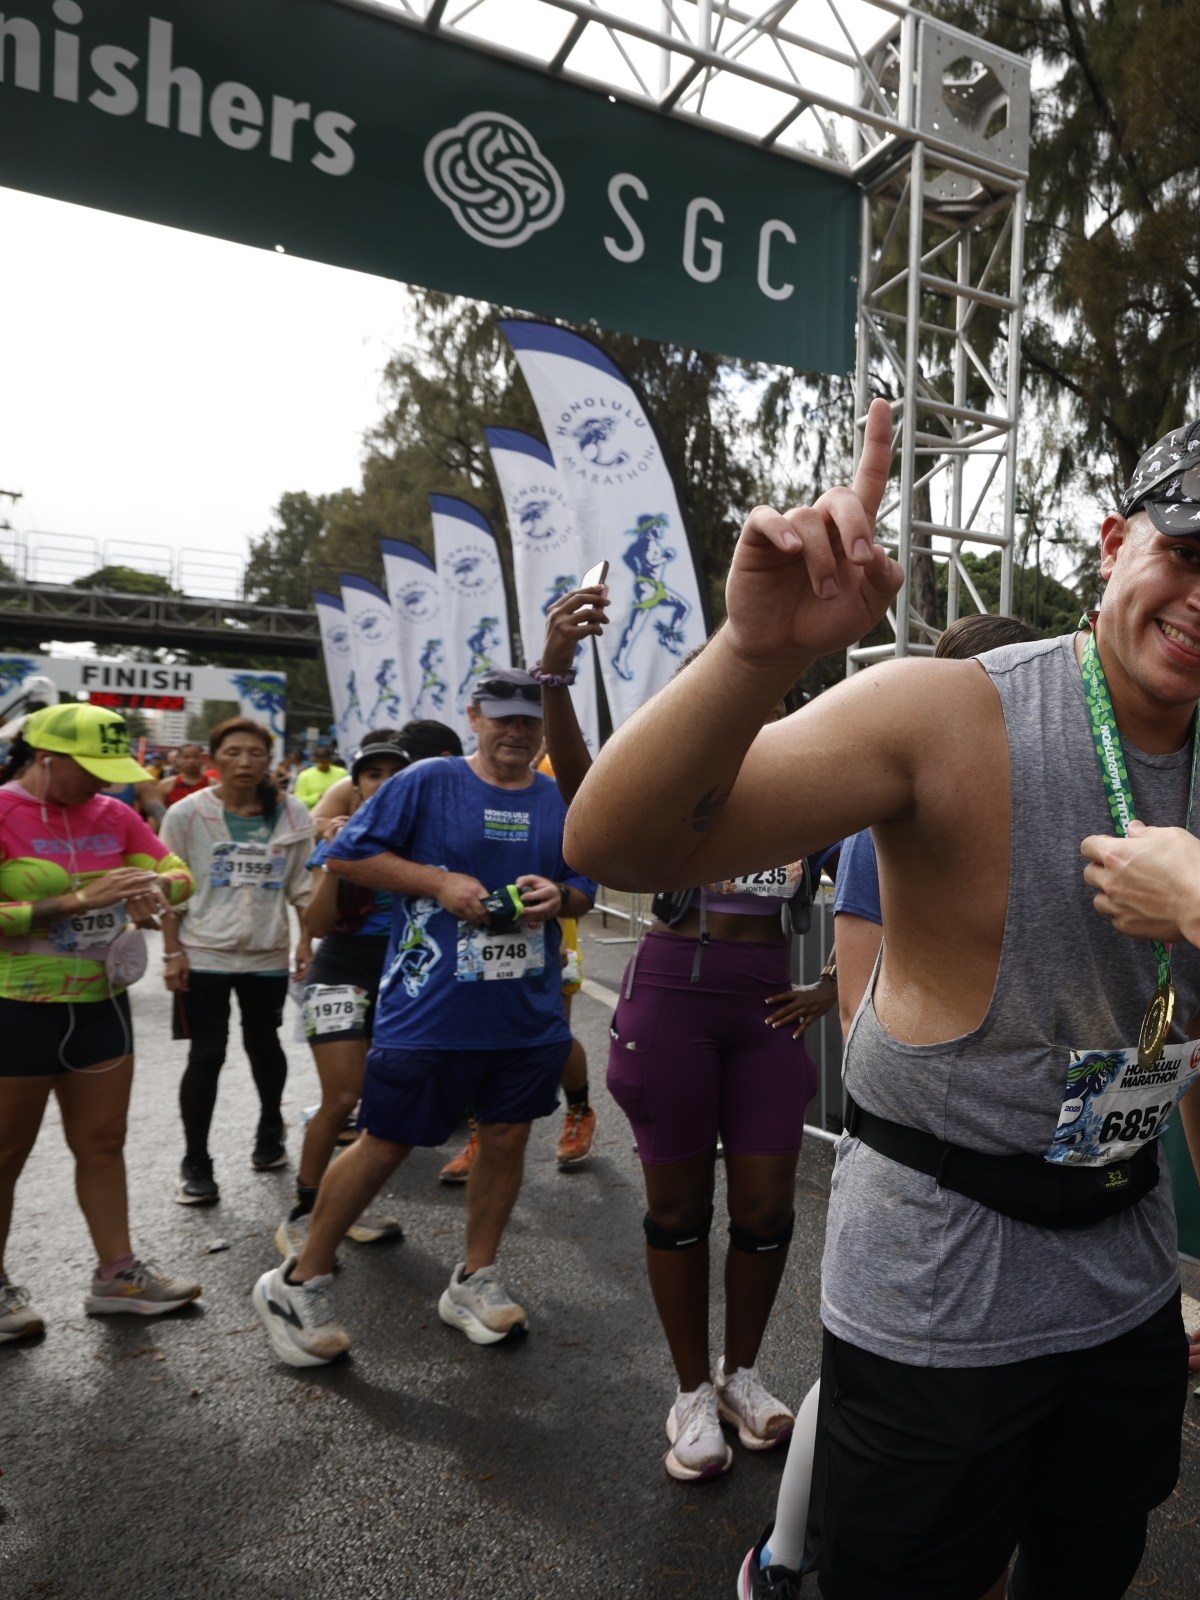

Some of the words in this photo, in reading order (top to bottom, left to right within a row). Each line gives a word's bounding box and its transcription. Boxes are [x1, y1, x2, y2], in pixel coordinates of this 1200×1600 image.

[603, 172, 797, 301] SGC
[555, 397, 647, 436] HONOLULU
[563, 448, 655, 485] MARATHON
[81, 664, 192, 691] FINISH
[1099, 724, 1122, 790] MARATHON
[1114, 792, 1131, 839] OLULU
[224, 860, 274, 875] 31559
[482, 943, 527, 961] 6748
[314, 1001, 354, 1018] 1978
[1119, 1070, 1179, 1089] MARATHON
[1063, 1104, 1082, 1113] 2025
[1098, 1100, 1173, 1144] 6852
